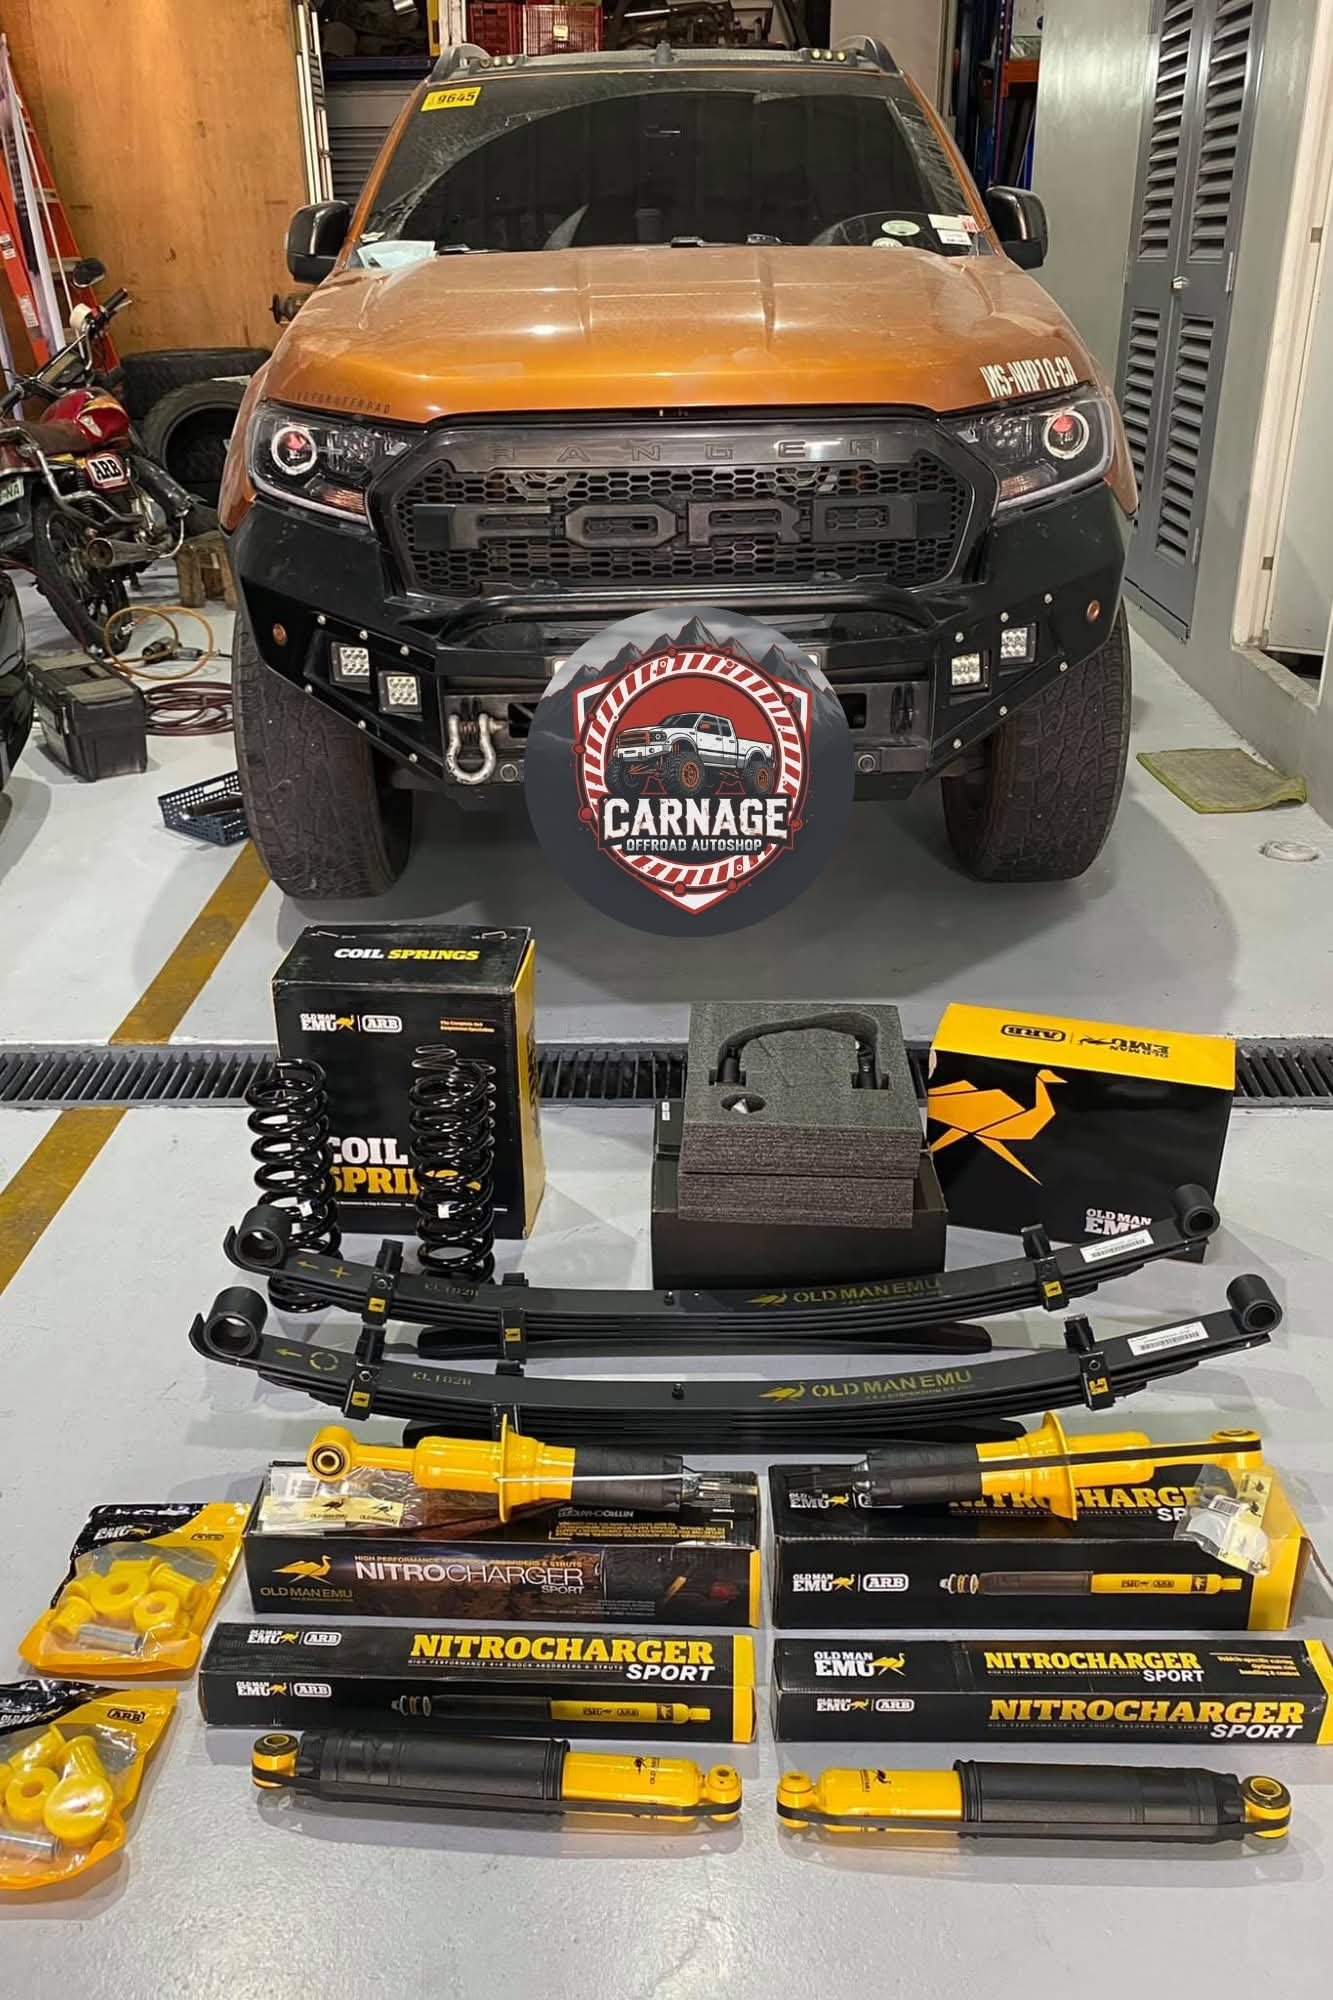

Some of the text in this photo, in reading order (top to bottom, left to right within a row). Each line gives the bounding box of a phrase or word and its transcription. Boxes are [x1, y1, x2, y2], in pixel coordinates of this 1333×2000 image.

[489, 439, 879, 462] RANGER
[90, 459, 121, 480] ARB
[449, 500, 916, 549] FORD
[334, 949, 480, 960] COIL SPRINGS
[301, 1020, 336, 1032] EMU
[367, 1018, 399, 1030] ARB
[1007, 1026, 1059, 1040] ARB
[1112, 1038, 1171, 1055] EMU
[1086, 1208, 1152, 1226] OLD MAN
[793, 1291, 837, 1303] OLD
[839, 1284, 889, 1300] MAN
[893, 1278, 942, 1294] EMU
[812, 1383, 860, 1397] OLD
[863, 1376, 916, 1394] MAN
[920, 1370, 973, 1387] EMU
[355, 1562, 584, 1586] NITROCHARGER
[792, 1580, 833, 1592] EMU
[867, 1577, 905, 1588] ARB
[260, 1586, 353, 1599] OLD MAN EMU
[541, 1585, 584, 1595] SPORT
[247, 1634, 281, 1644] EMU
[307, 1634, 338, 1643] ARB
[410, 1634, 714, 1664] NITROCHARGER
[814, 1651, 874, 1661] OLD MAN
[984, 1652, 1202, 1669] NITROCHARGER
[626, 1664, 716, 1681] SPORT
[814, 1659, 875, 1677] EMU
[1143, 1670, 1205, 1682] SPORT
[237, 1686, 269, 1697] EMU
[299, 1685, 328, 1695] ARB
[817, 1702, 851, 1712] EMU
[880, 1700, 910, 1710] ARB
[989, 1700, 1305, 1724] NITROCHARGER
[111, 1709, 142, 1723] ARB
[1210, 1724, 1304, 1738] SPORT
